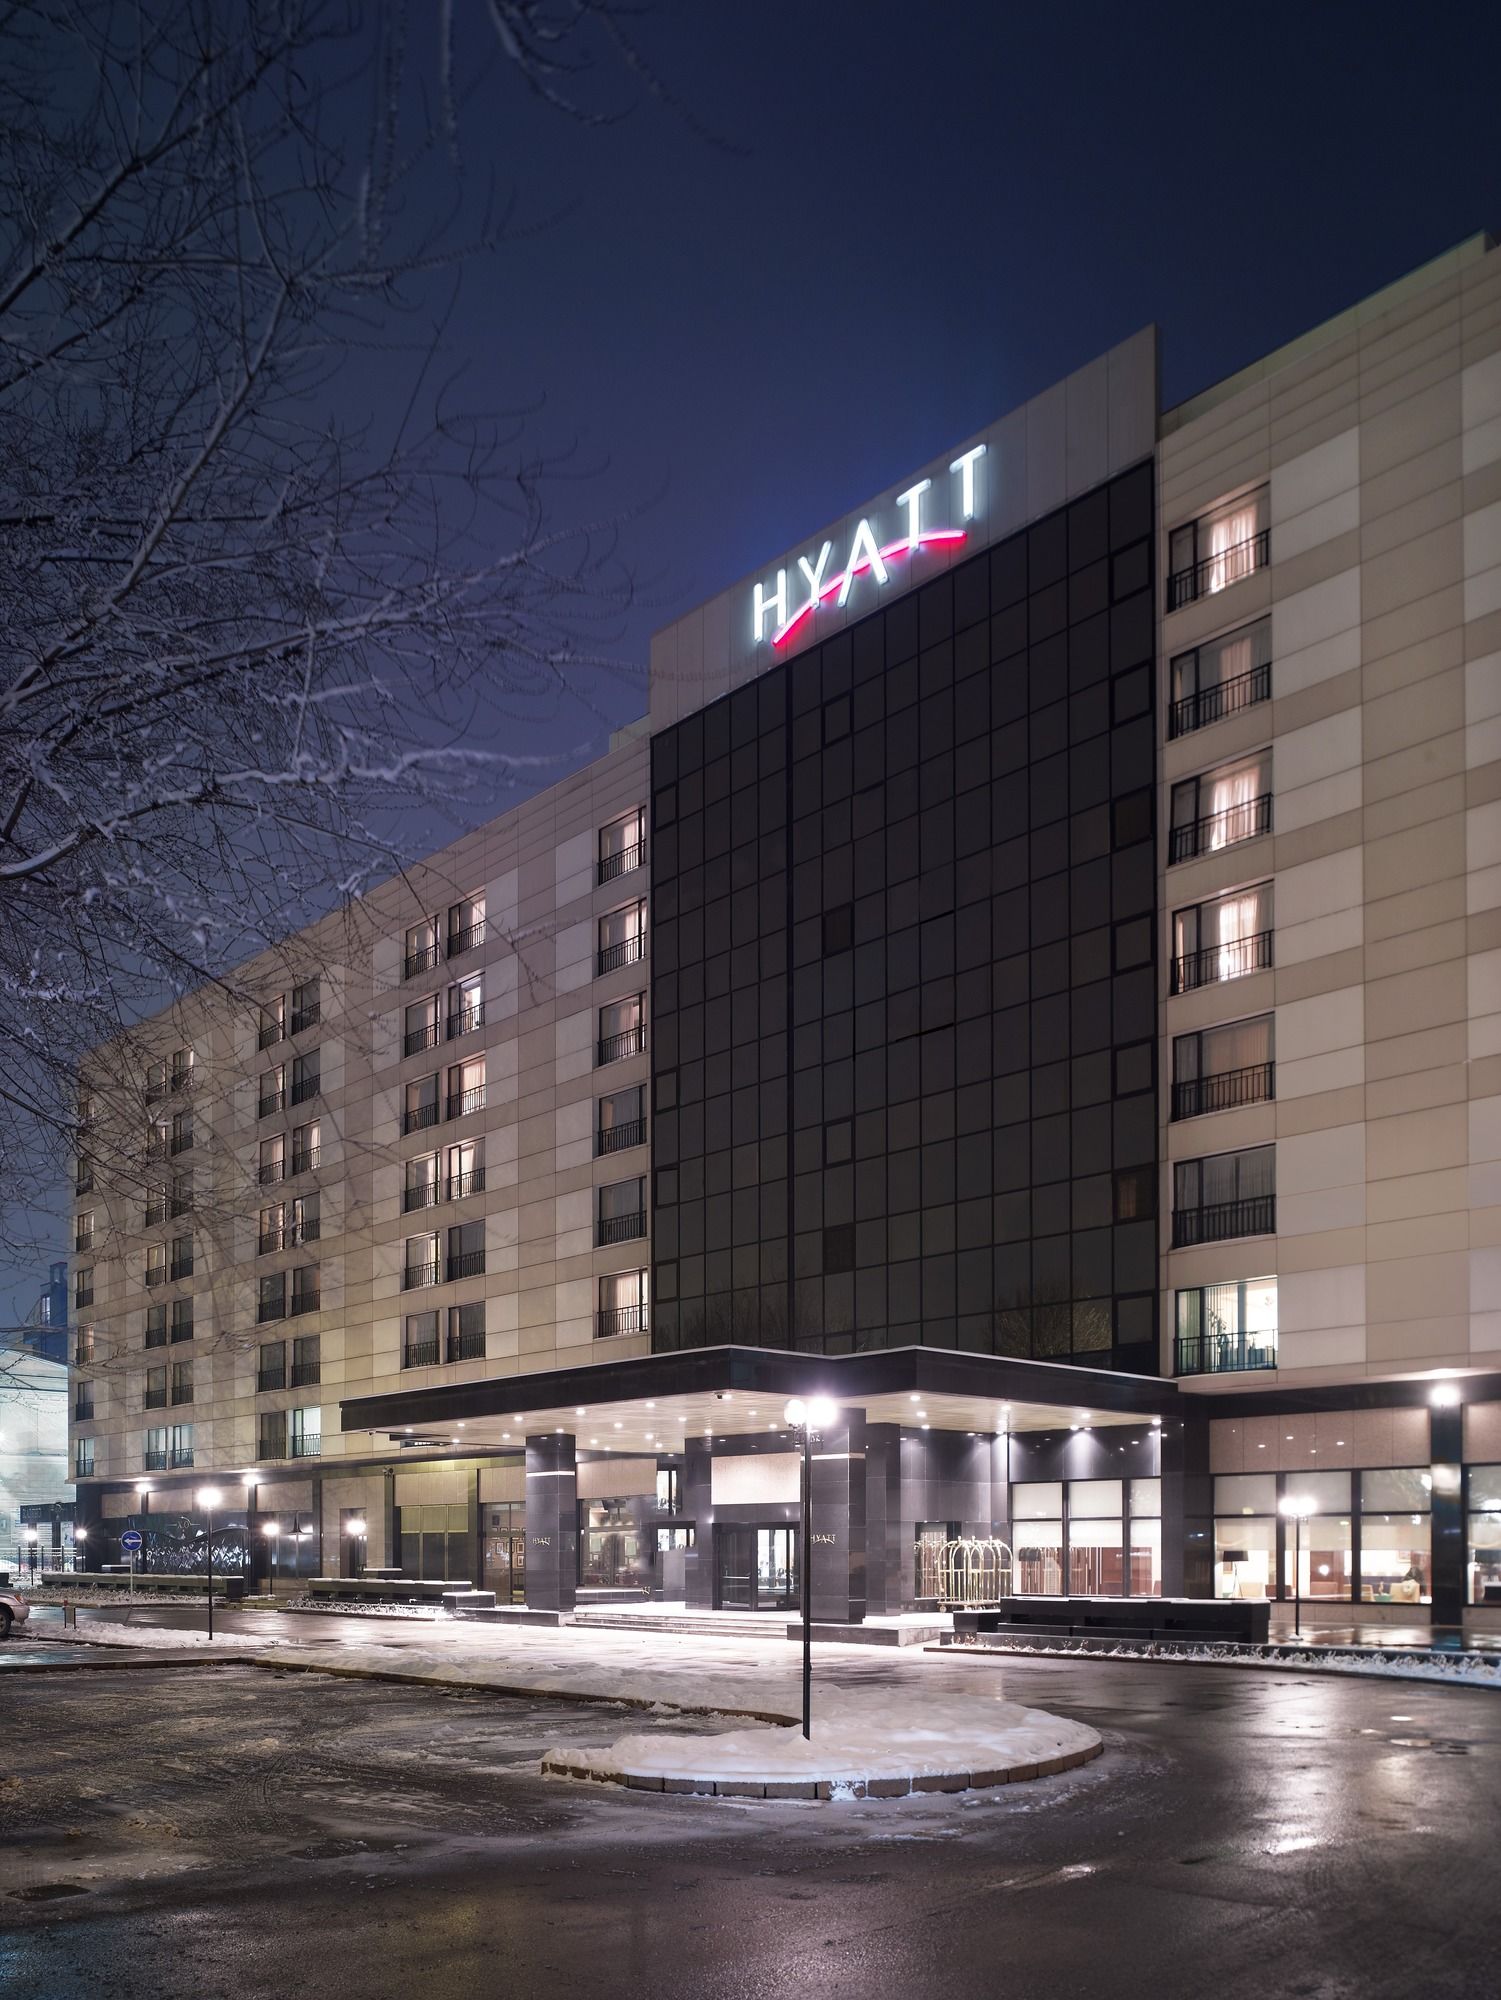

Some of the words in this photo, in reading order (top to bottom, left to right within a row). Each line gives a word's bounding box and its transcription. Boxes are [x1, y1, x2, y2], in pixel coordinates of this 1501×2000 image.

[753, 444, 986, 642] HYATT
[532, 1537, 551, 1545] HYATT
[811, 1534, 836, 1545] HYATT
